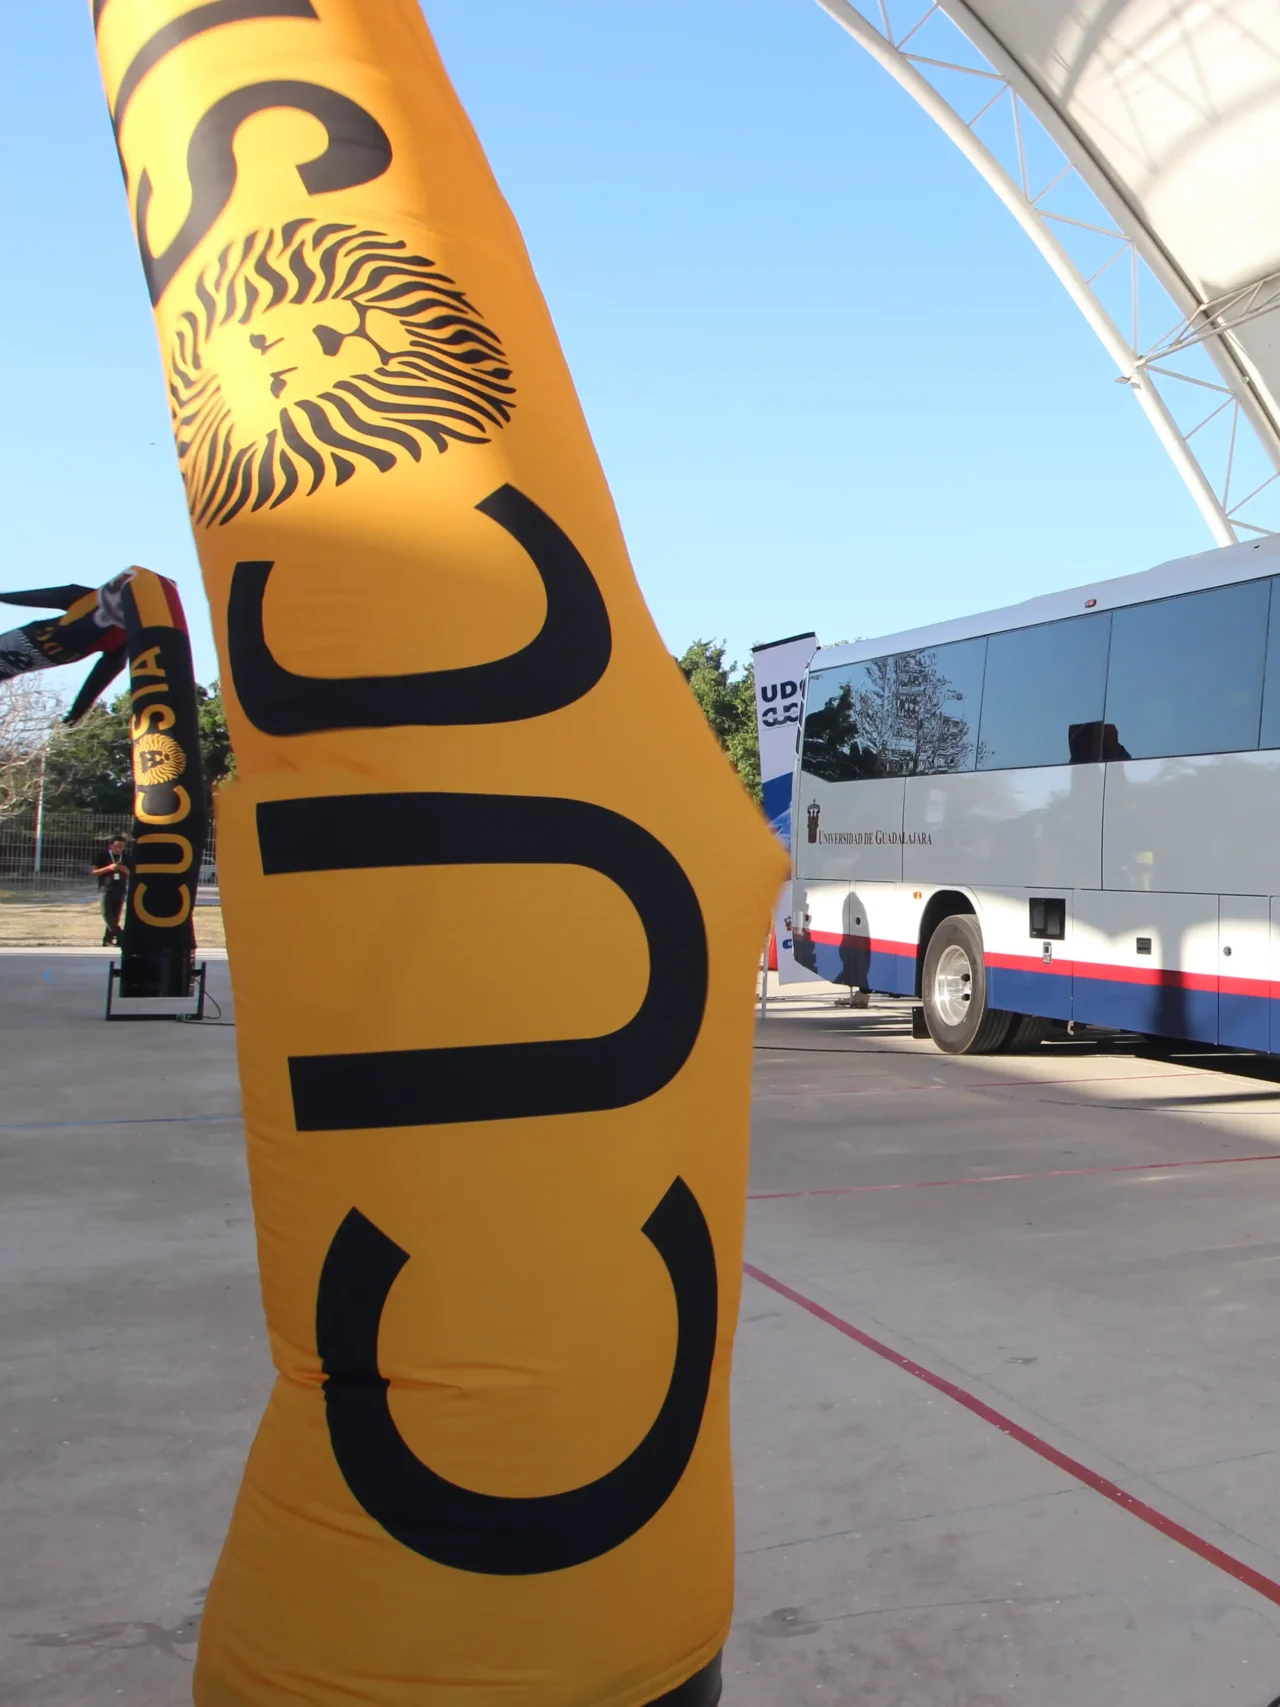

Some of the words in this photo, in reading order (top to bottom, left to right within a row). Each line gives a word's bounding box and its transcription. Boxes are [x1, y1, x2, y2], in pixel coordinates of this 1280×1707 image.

[818, 830, 863, 845] UNIVERSIDAD
[864, 832, 873, 845] DE
[875, 830, 932, 845] GUADALAJARA
